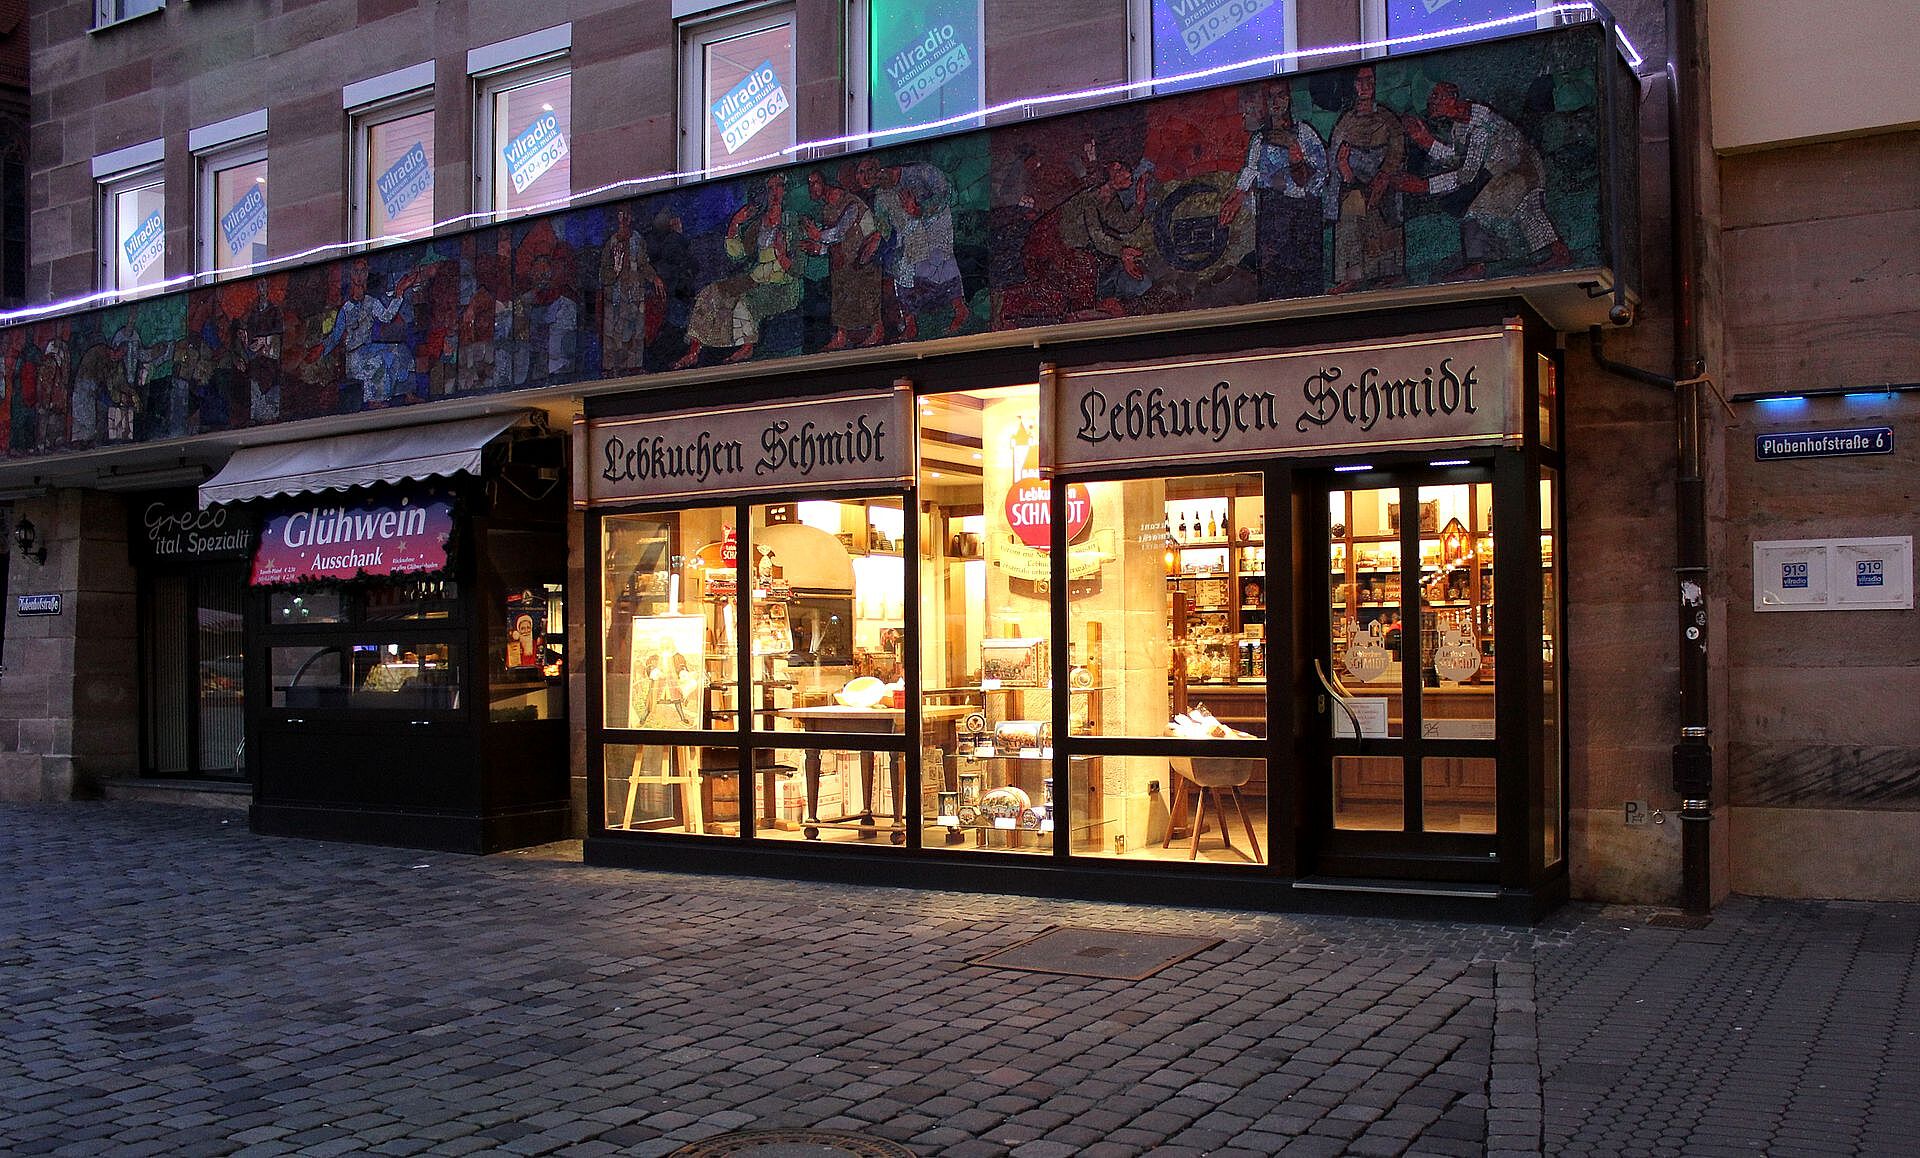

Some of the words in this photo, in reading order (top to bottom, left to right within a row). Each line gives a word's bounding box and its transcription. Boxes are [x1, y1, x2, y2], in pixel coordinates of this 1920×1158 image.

[887, 24, 954, 79] vilradio
[715, 69, 773, 121] vilradio
[506, 116, 556, 163] vilradio
[381, 150, 424, 194] vilradio
[224, 191, 261, 233] vilradio
[126, 216, 161, 255] vilradio
[1076, 380, 1278, 447] Lebkuchen
[1296, 357, 1479, 432] Schmidt
[602, 431, 744, 485] Lebkuchen
[755, 414, 885, 476] Schmidt
[1765, 435, 1869, 454] Plobenhofstraße
[1876, 433, 1884, 448] 6
[1019, 487, 1077, 502] Lebkun
[144, 502, 227, 540] Greco
[156, 533, 183, 554] ital.
[187, 528, 252, 556] Spezialit
[283, 497, 426, 548] Glühwein
[311, 547, 384, 571] Ausschank
